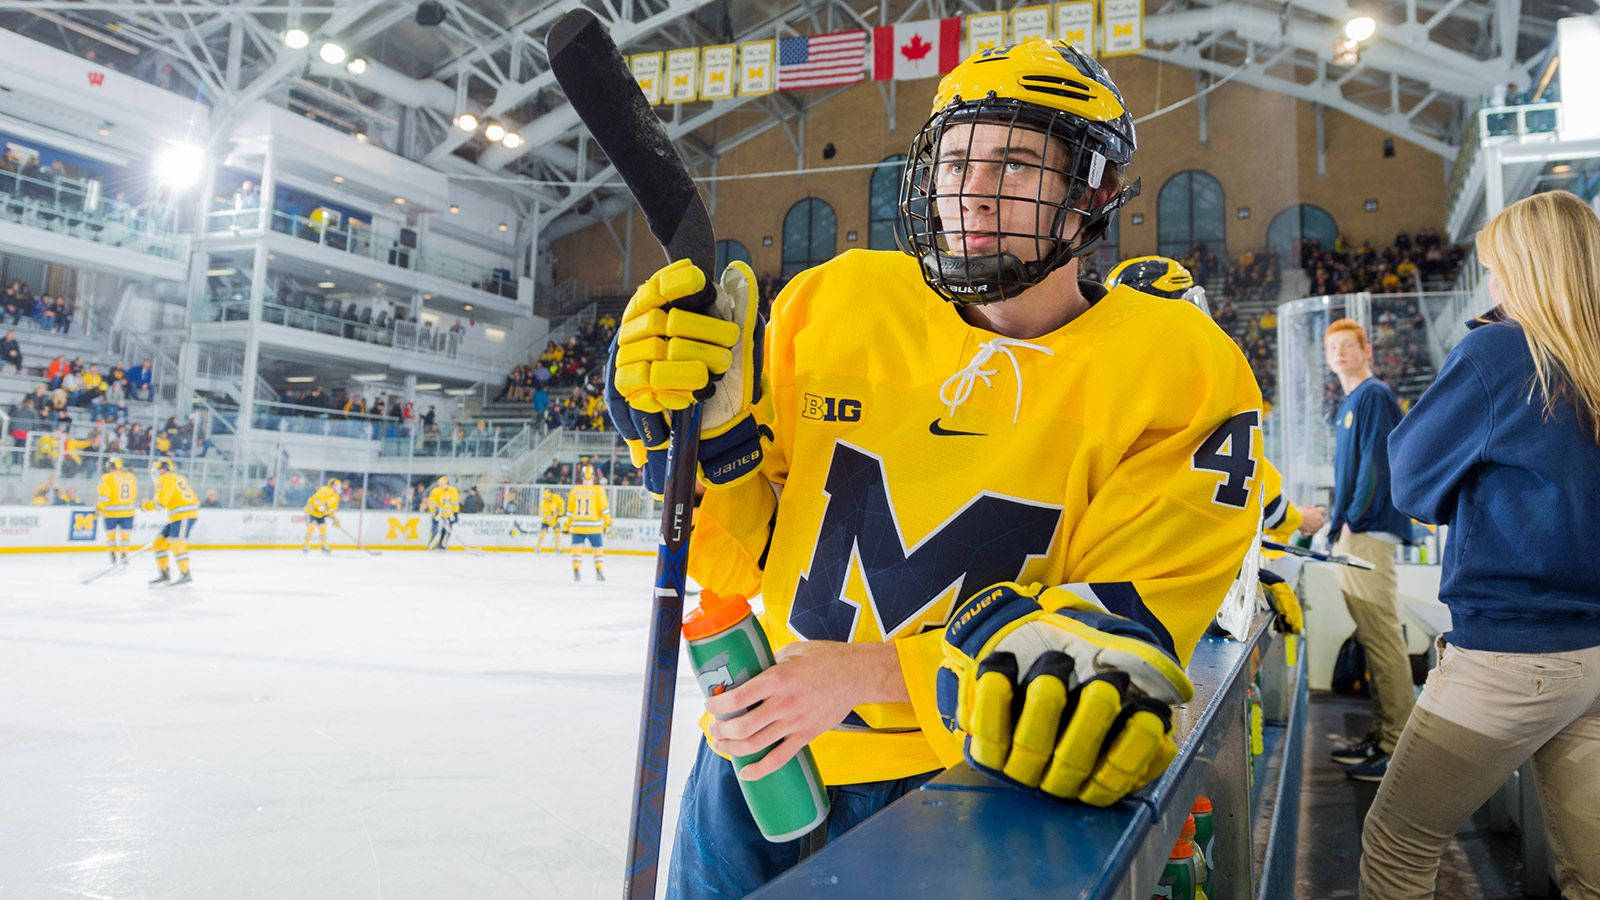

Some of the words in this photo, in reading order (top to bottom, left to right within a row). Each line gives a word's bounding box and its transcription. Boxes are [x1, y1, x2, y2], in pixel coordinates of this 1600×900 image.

[712, 449, 760, 478] BAUER
[1190, 408, 1261, 510] 4
[120, 483, 130, 500] 8
[575, 497, 592, 516] 11
[73, 513, 97, 531] M
[386, 517, 420, 539] M
[672, 502, 684, 542] LITE
[787, 438, 1066, 643] M
